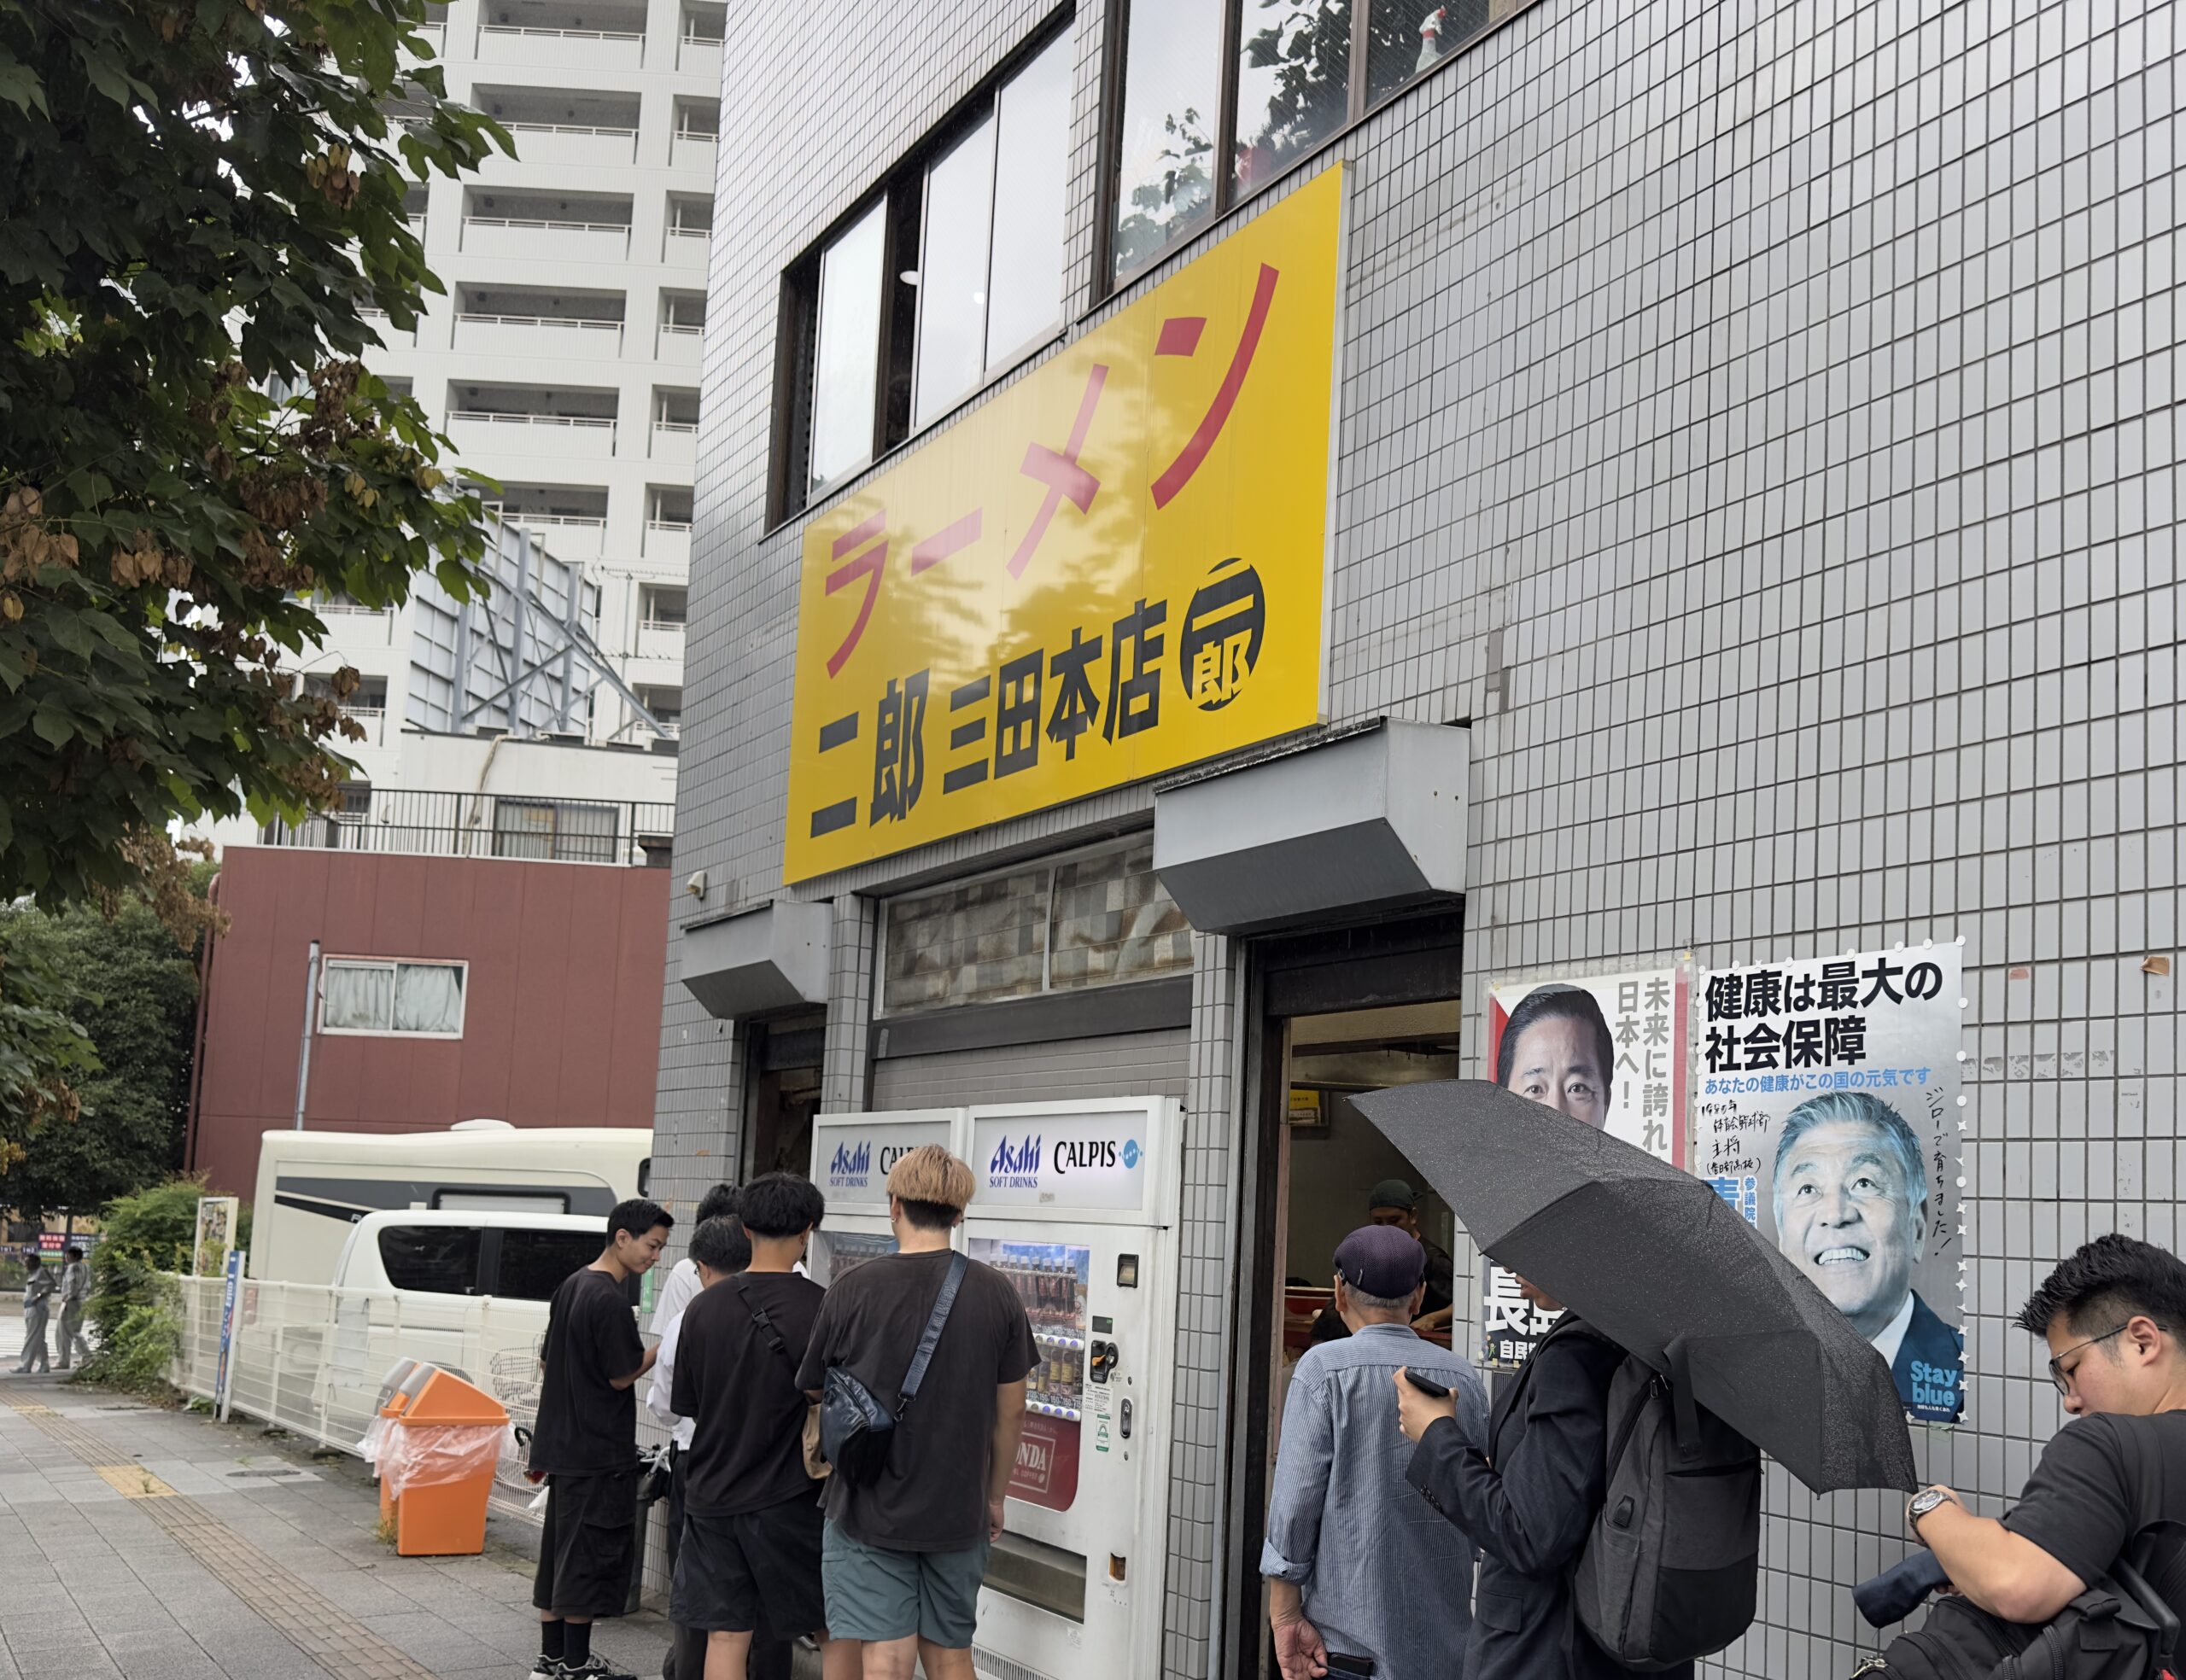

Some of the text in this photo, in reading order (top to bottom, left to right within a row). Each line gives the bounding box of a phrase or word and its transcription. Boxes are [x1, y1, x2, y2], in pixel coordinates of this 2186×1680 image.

[825, 263, 1279, 680] ラーメン
[1705, 957, 1943, 1022] 健康は最大の
[1615, 980, 1640, 1109] 日本へ！
[1704, 1015, 1867, 1073] 社会保障
[1642, 977, 1670, 1158] 未来に誇れ
[1704, 1067, 1932, 1094] あなたの健康がこの国の元気です
[831, 1140, 871, 1175] Asahi
[990, 1134, 1041, 1174] Asahi
[1054, 1140, 1116, 1175] CALPIS
[1712, 1135, 1740, 1159] 主将
[829, 1176, 868, 1187] SOFT DRINKS
[989, 1175, 1038, 1188] SOFT DRINKS
[1744, 1175, 1756, 1227] 参議院
[1910, 1360, 1957, 1387] Stay
[1912, 1381, 1955, 1407] blue
